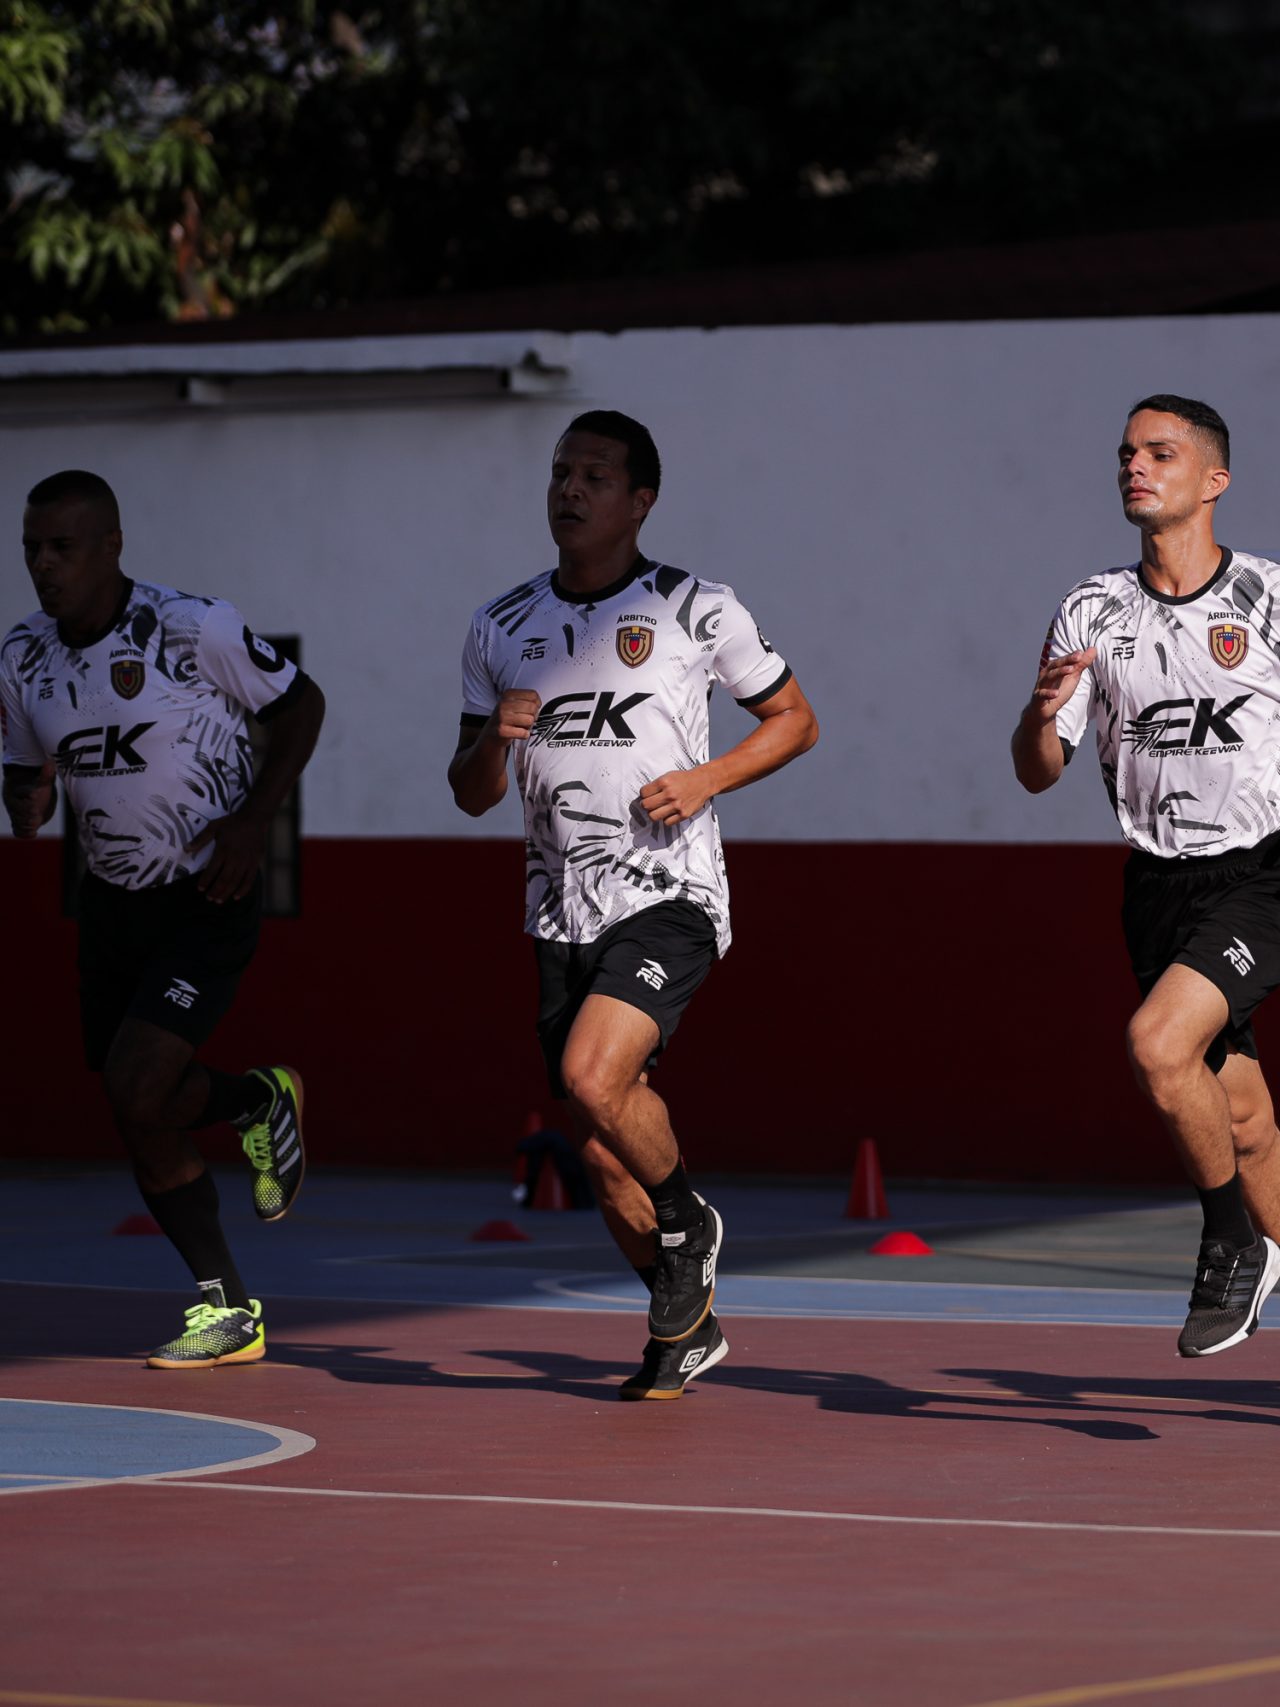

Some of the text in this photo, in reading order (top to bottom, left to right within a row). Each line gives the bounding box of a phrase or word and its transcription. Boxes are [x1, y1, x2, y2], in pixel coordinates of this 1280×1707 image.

[616, 614, 657, 626] ÁRBITRO
[1207, 611, 1250, 623] ÁRBITRO
[521, 646, 546, 661] RS
[1112, 645, 1135, 661] RS
[532, 691, 656, 746] EK
[1121, 692, 1256, 754] EK
[55, 721, 158, 774] EK
[547, 740, 636, 748] EMPIRE KEEWAY
[1149, 744, 1244, 758] EMPIRE KEEWAY
[1223, 946, 1251, 977] RS
[636, 966, 664, 991] RS
[164, 987, 195, 1009] RS
